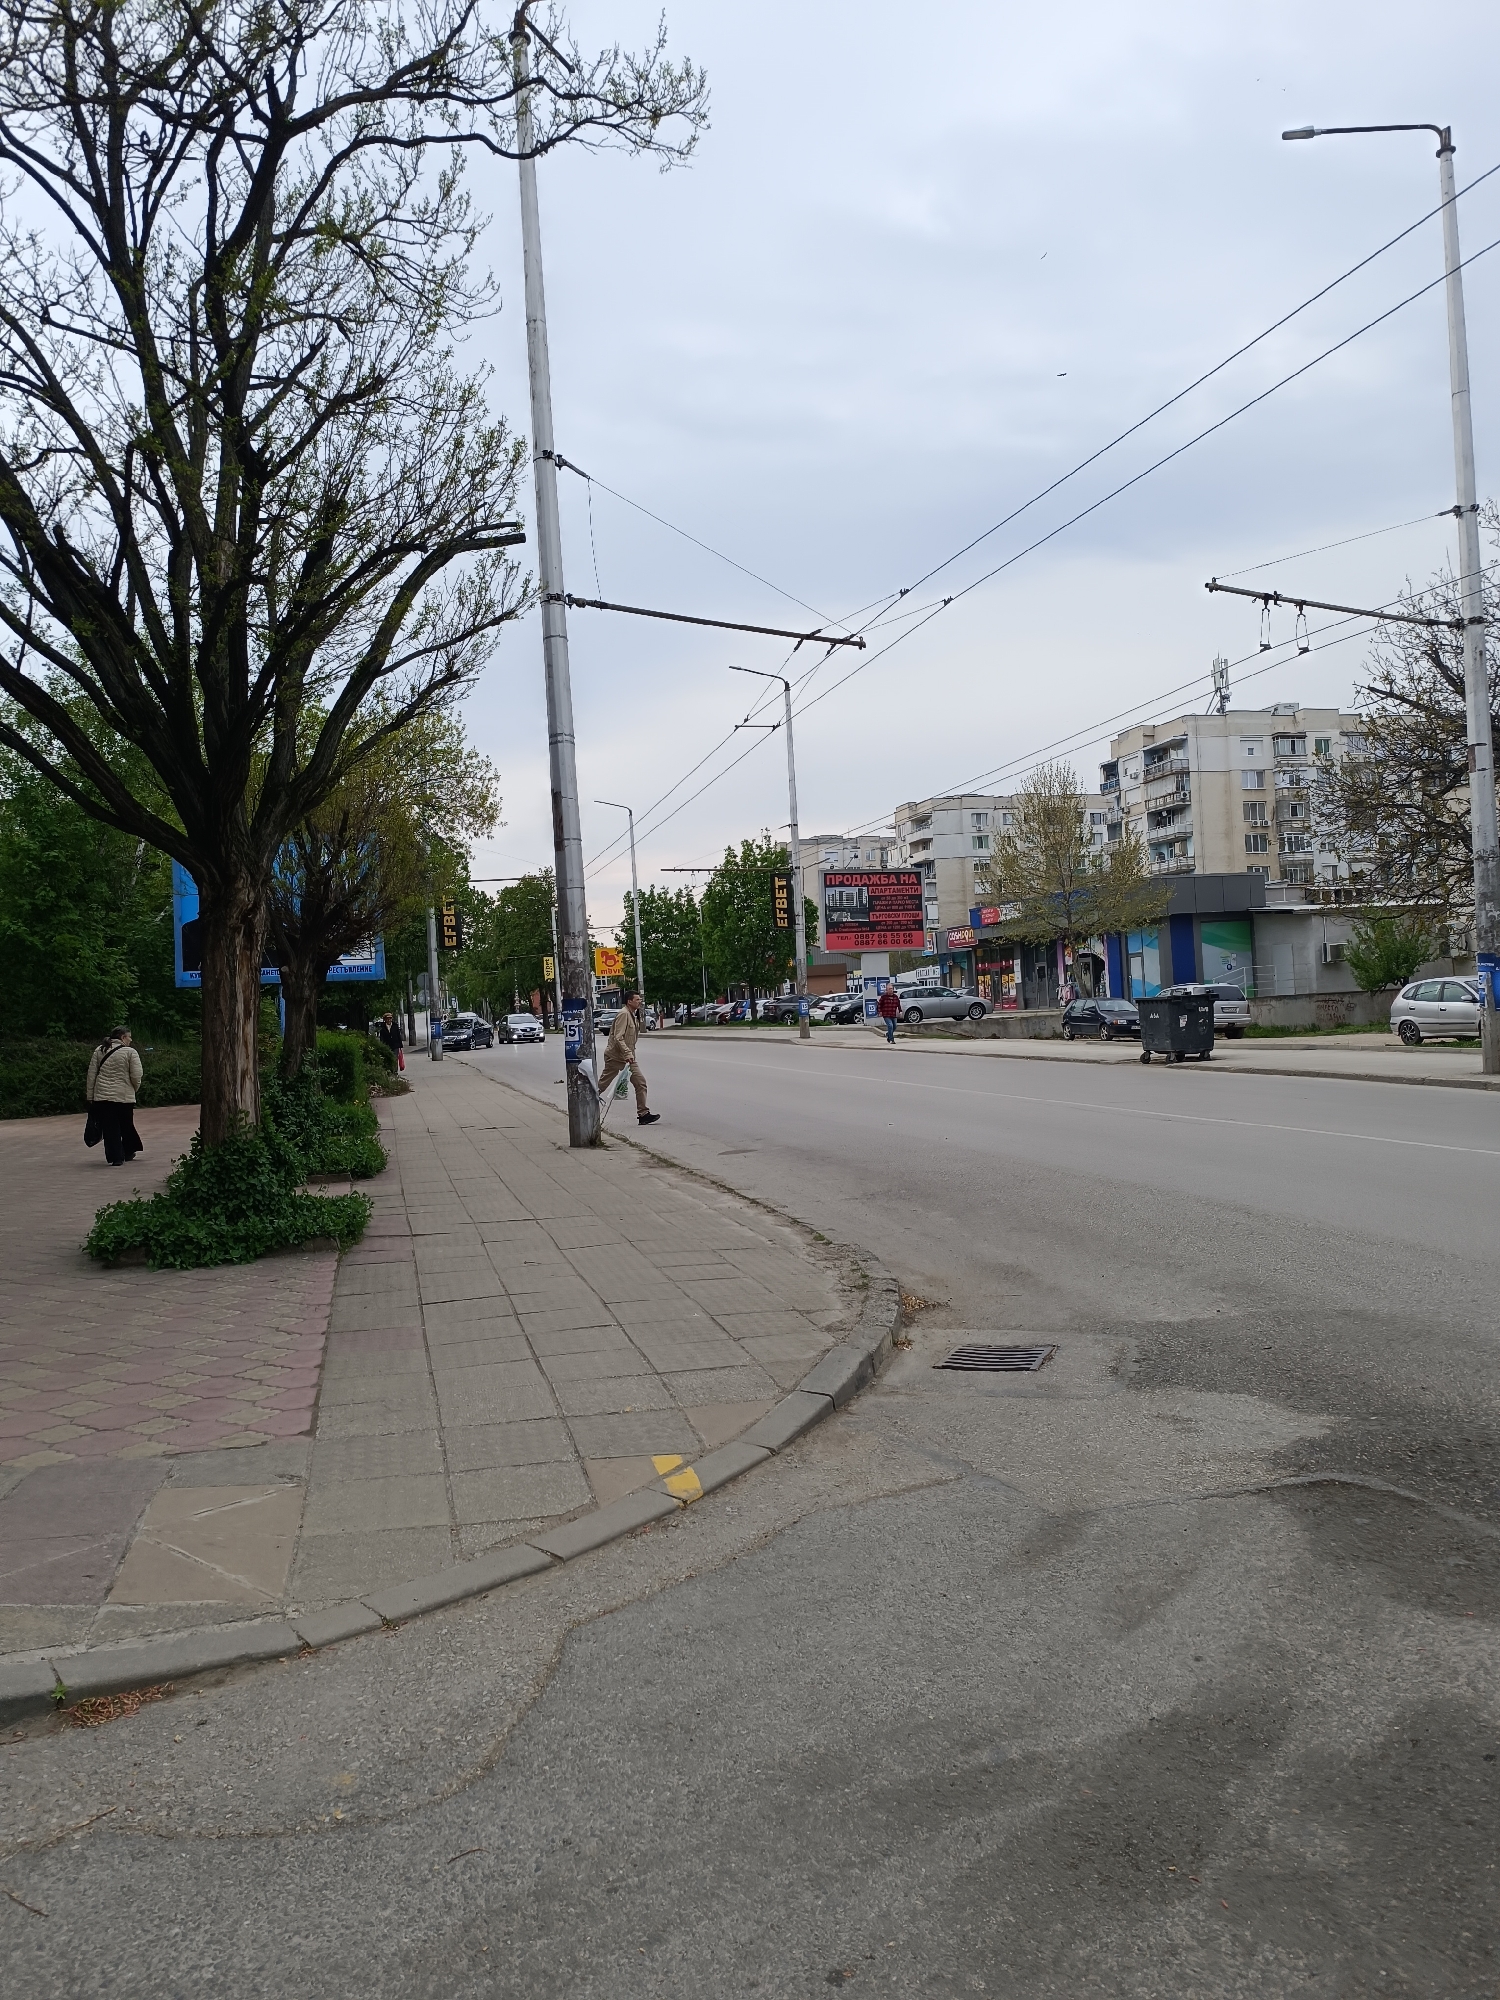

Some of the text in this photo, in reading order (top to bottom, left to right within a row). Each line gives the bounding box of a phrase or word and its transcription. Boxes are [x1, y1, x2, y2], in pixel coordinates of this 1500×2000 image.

[826, 873, 918, 886] ПРОДАЖБА НА
[870, 887, 919, 895] АПАРТАМЕНТИ
[775, 876, 788, 927] EFBET
[565, 1025, 576, 1037] 15
